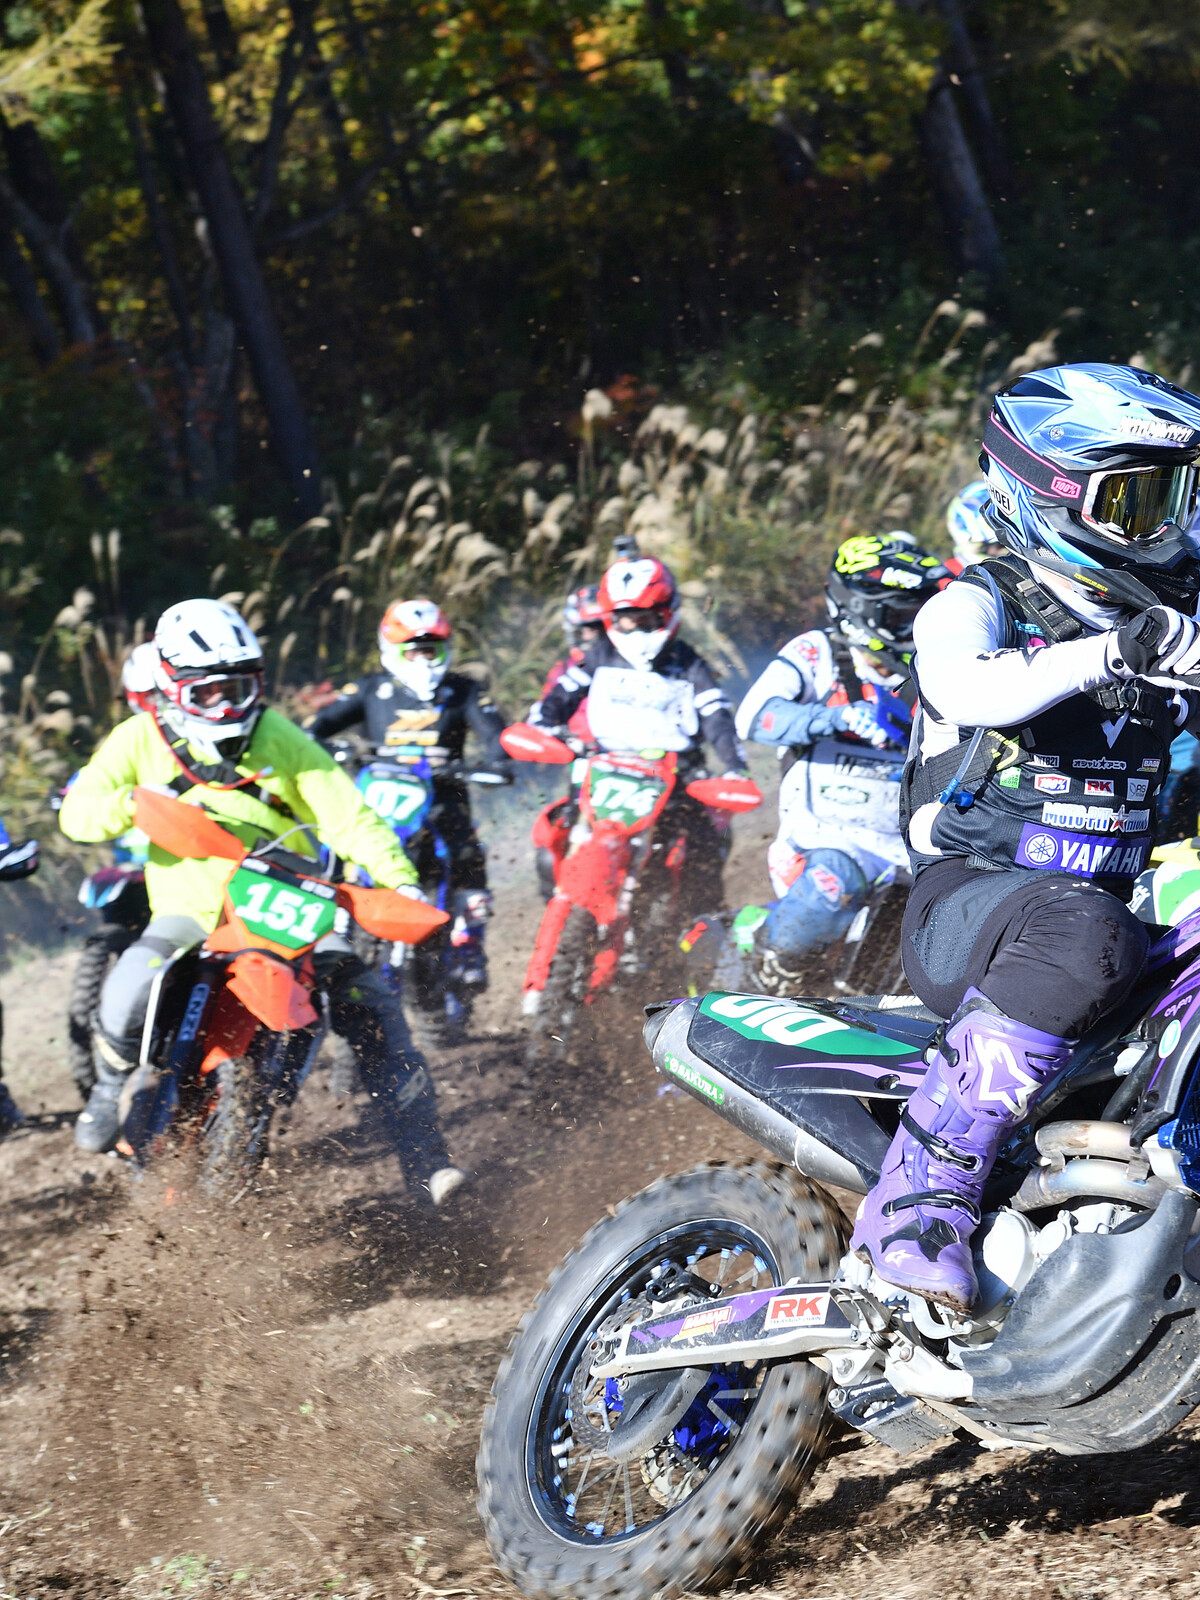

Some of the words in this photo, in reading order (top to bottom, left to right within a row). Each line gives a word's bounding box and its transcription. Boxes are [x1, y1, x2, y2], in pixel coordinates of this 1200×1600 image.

[1055, 479, 1078, 494] 100%
[1040, 778, 1067, 791] 100%
[1088, 780, 1112, 793] RK
[1060, 840, 1143, 874] YAMAHA
[235, 882, 325, 943] 151
[677, 1064, 719, 1100] SAKURA
[771, 1297, 823, 1319] RK
